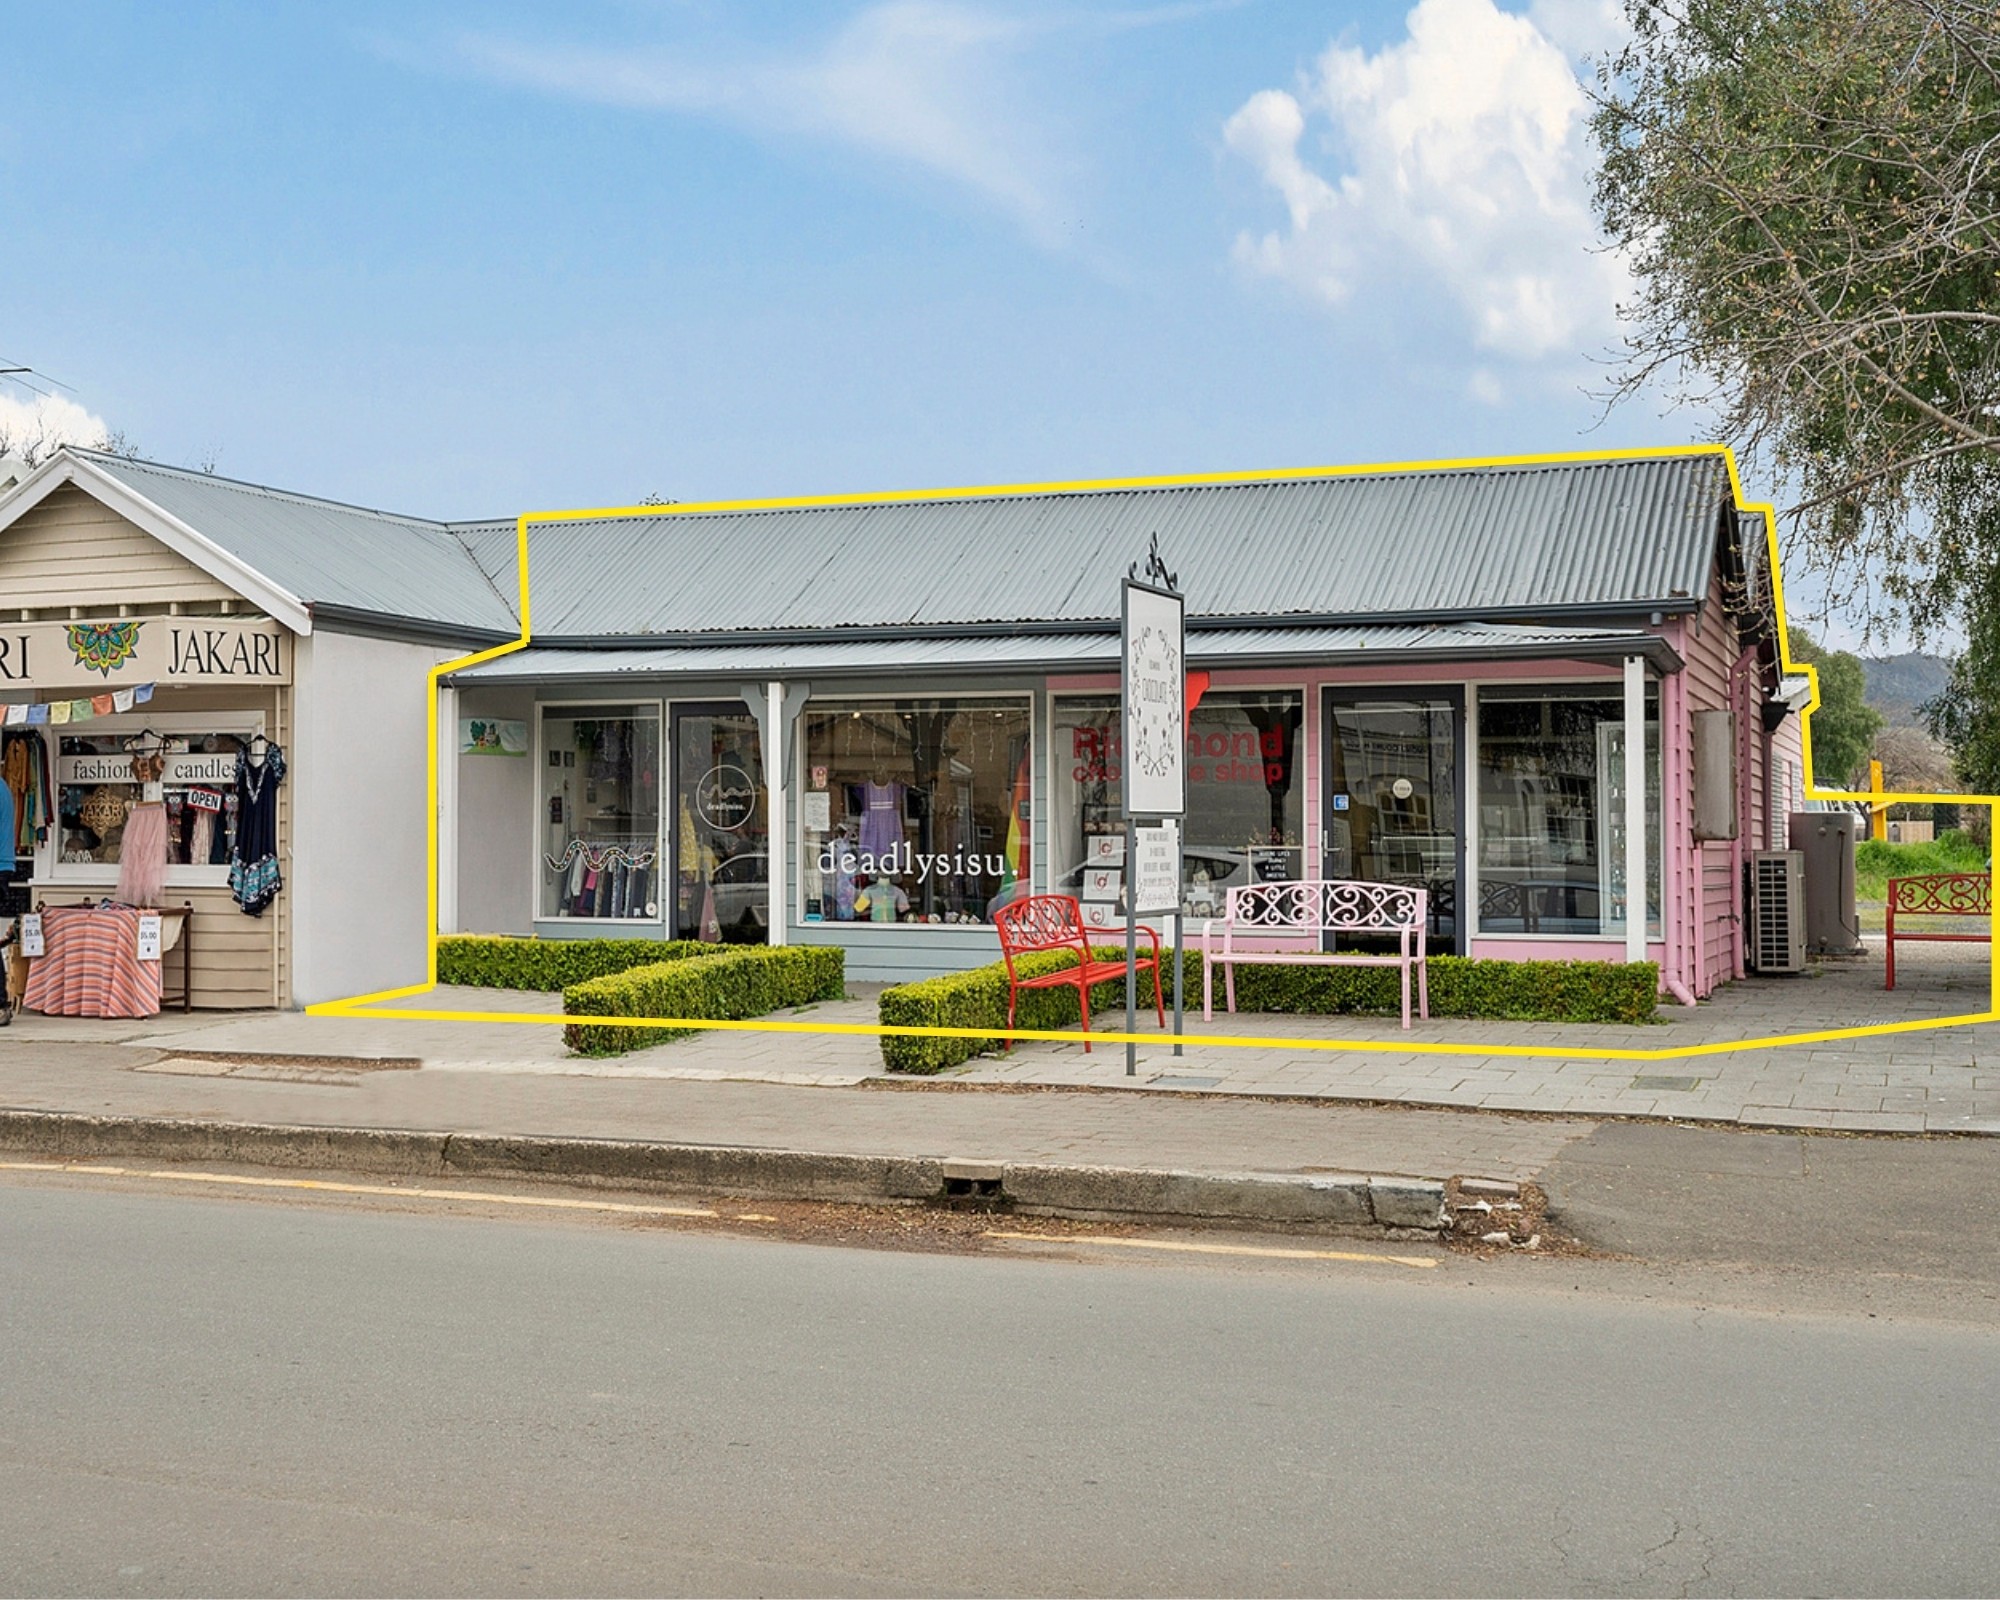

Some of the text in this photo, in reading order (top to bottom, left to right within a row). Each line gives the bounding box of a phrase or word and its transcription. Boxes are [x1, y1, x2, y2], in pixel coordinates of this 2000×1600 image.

[168, 629, 281, 676] JAKARI
[1072, 724, 1283, 759] Riond
[73, 759, 237, 779] fashion candles
[1215, 759, 1283, 785] shop
[191, 789, 219, 809] OPEN
[817, 840, 1018, 884] deadlysisu.
